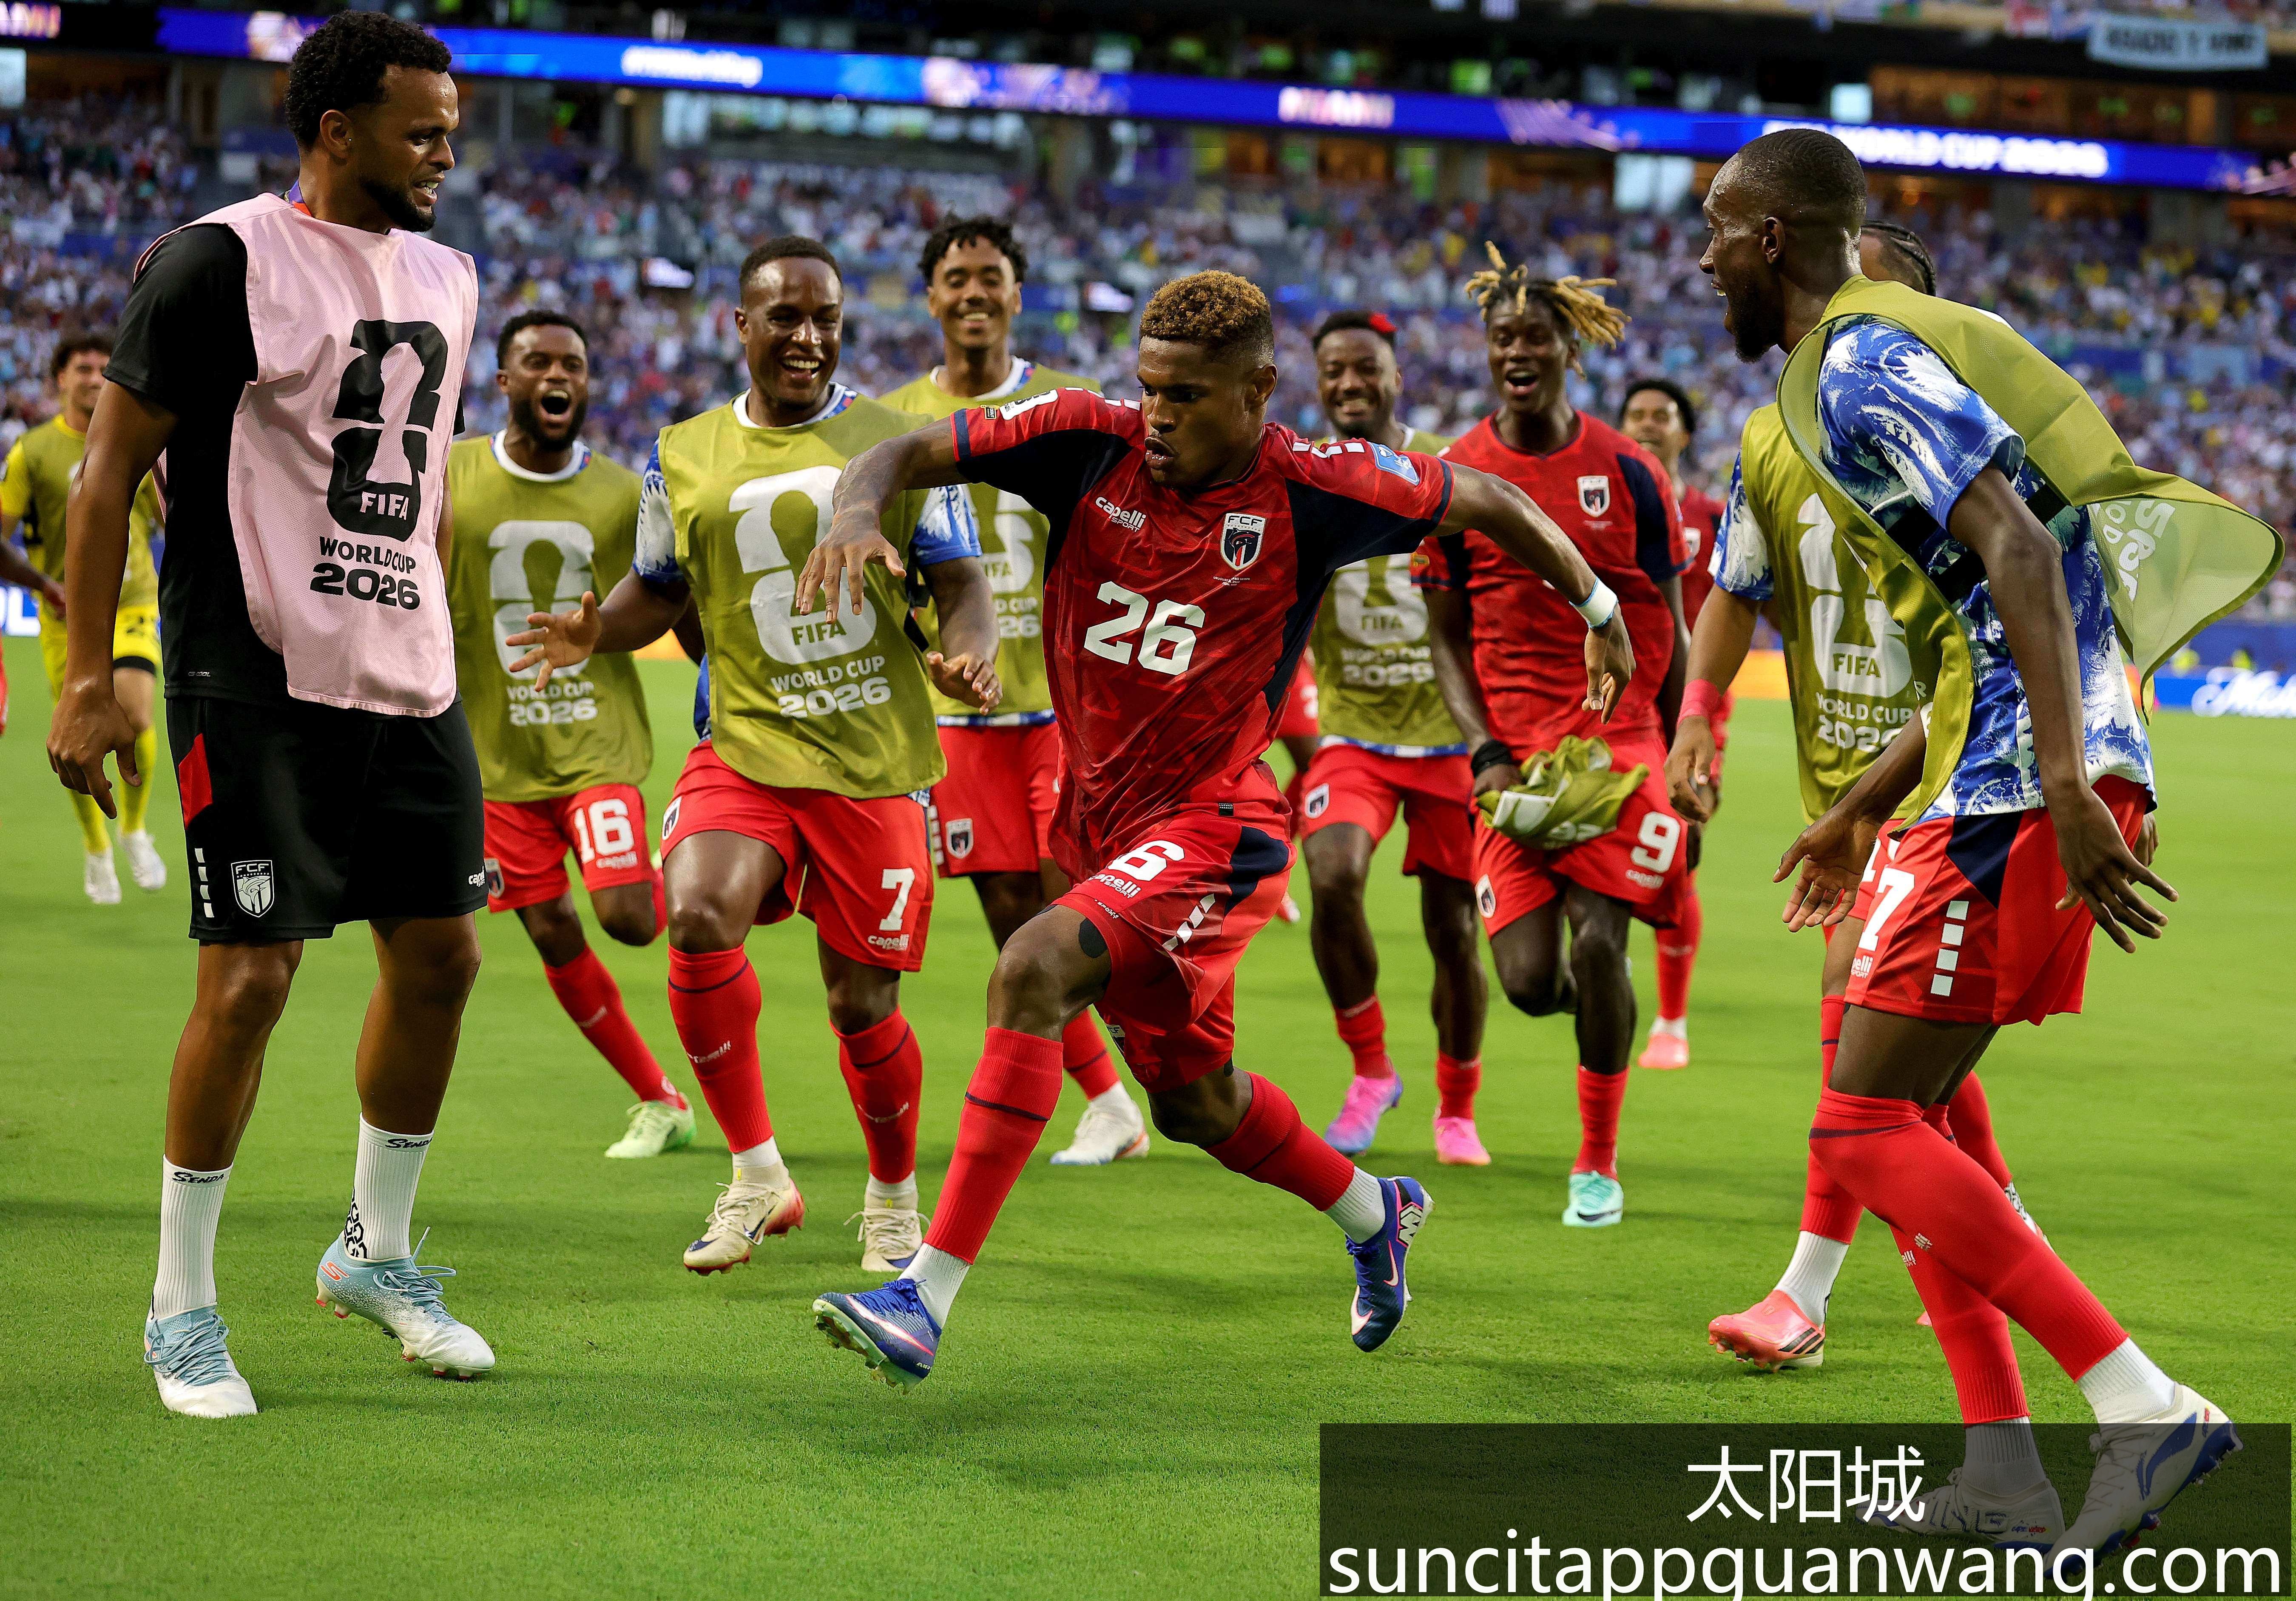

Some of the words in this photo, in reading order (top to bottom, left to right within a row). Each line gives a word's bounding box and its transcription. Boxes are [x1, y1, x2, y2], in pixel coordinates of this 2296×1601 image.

[360, 491, 409, 520] FIFA
[1096, 497, 1146, 528] capelli
[1228, 515, 1262, 526] FCF
[1111, 517, 1140, 532] SPORT
[320, 536, 391, 567] WORLD
[391, 552, 416, 574] CUP
[310, 562, 420, 610] 2026
[791, 620, 847, 645] FIFA
[999, 613, 1041, 638] 26
[1084, 581, 1205, 676] 26
[770, 666, 843, 693] WORLD
[846, 655, 885, 678] CUP
[1833, 653, 1881, 678] FIFA
[509, 698, 598, 726] 2026
[778, 676, 892, 718] 2026
[1872, 705, 1914, 724] CUP
[574, 798, 635, 864] 16
[1637, 812, 1680, 873] 9
[236, 863, 269, 874] FCF
[1107, 840, 1185, 881] 6
[879, 867, 915, 931] 7
[1103, 881, 1132, 898] SPORT
[1858, 867, 1915, 951] 7
[1852, 956, 1874, 974] elli
